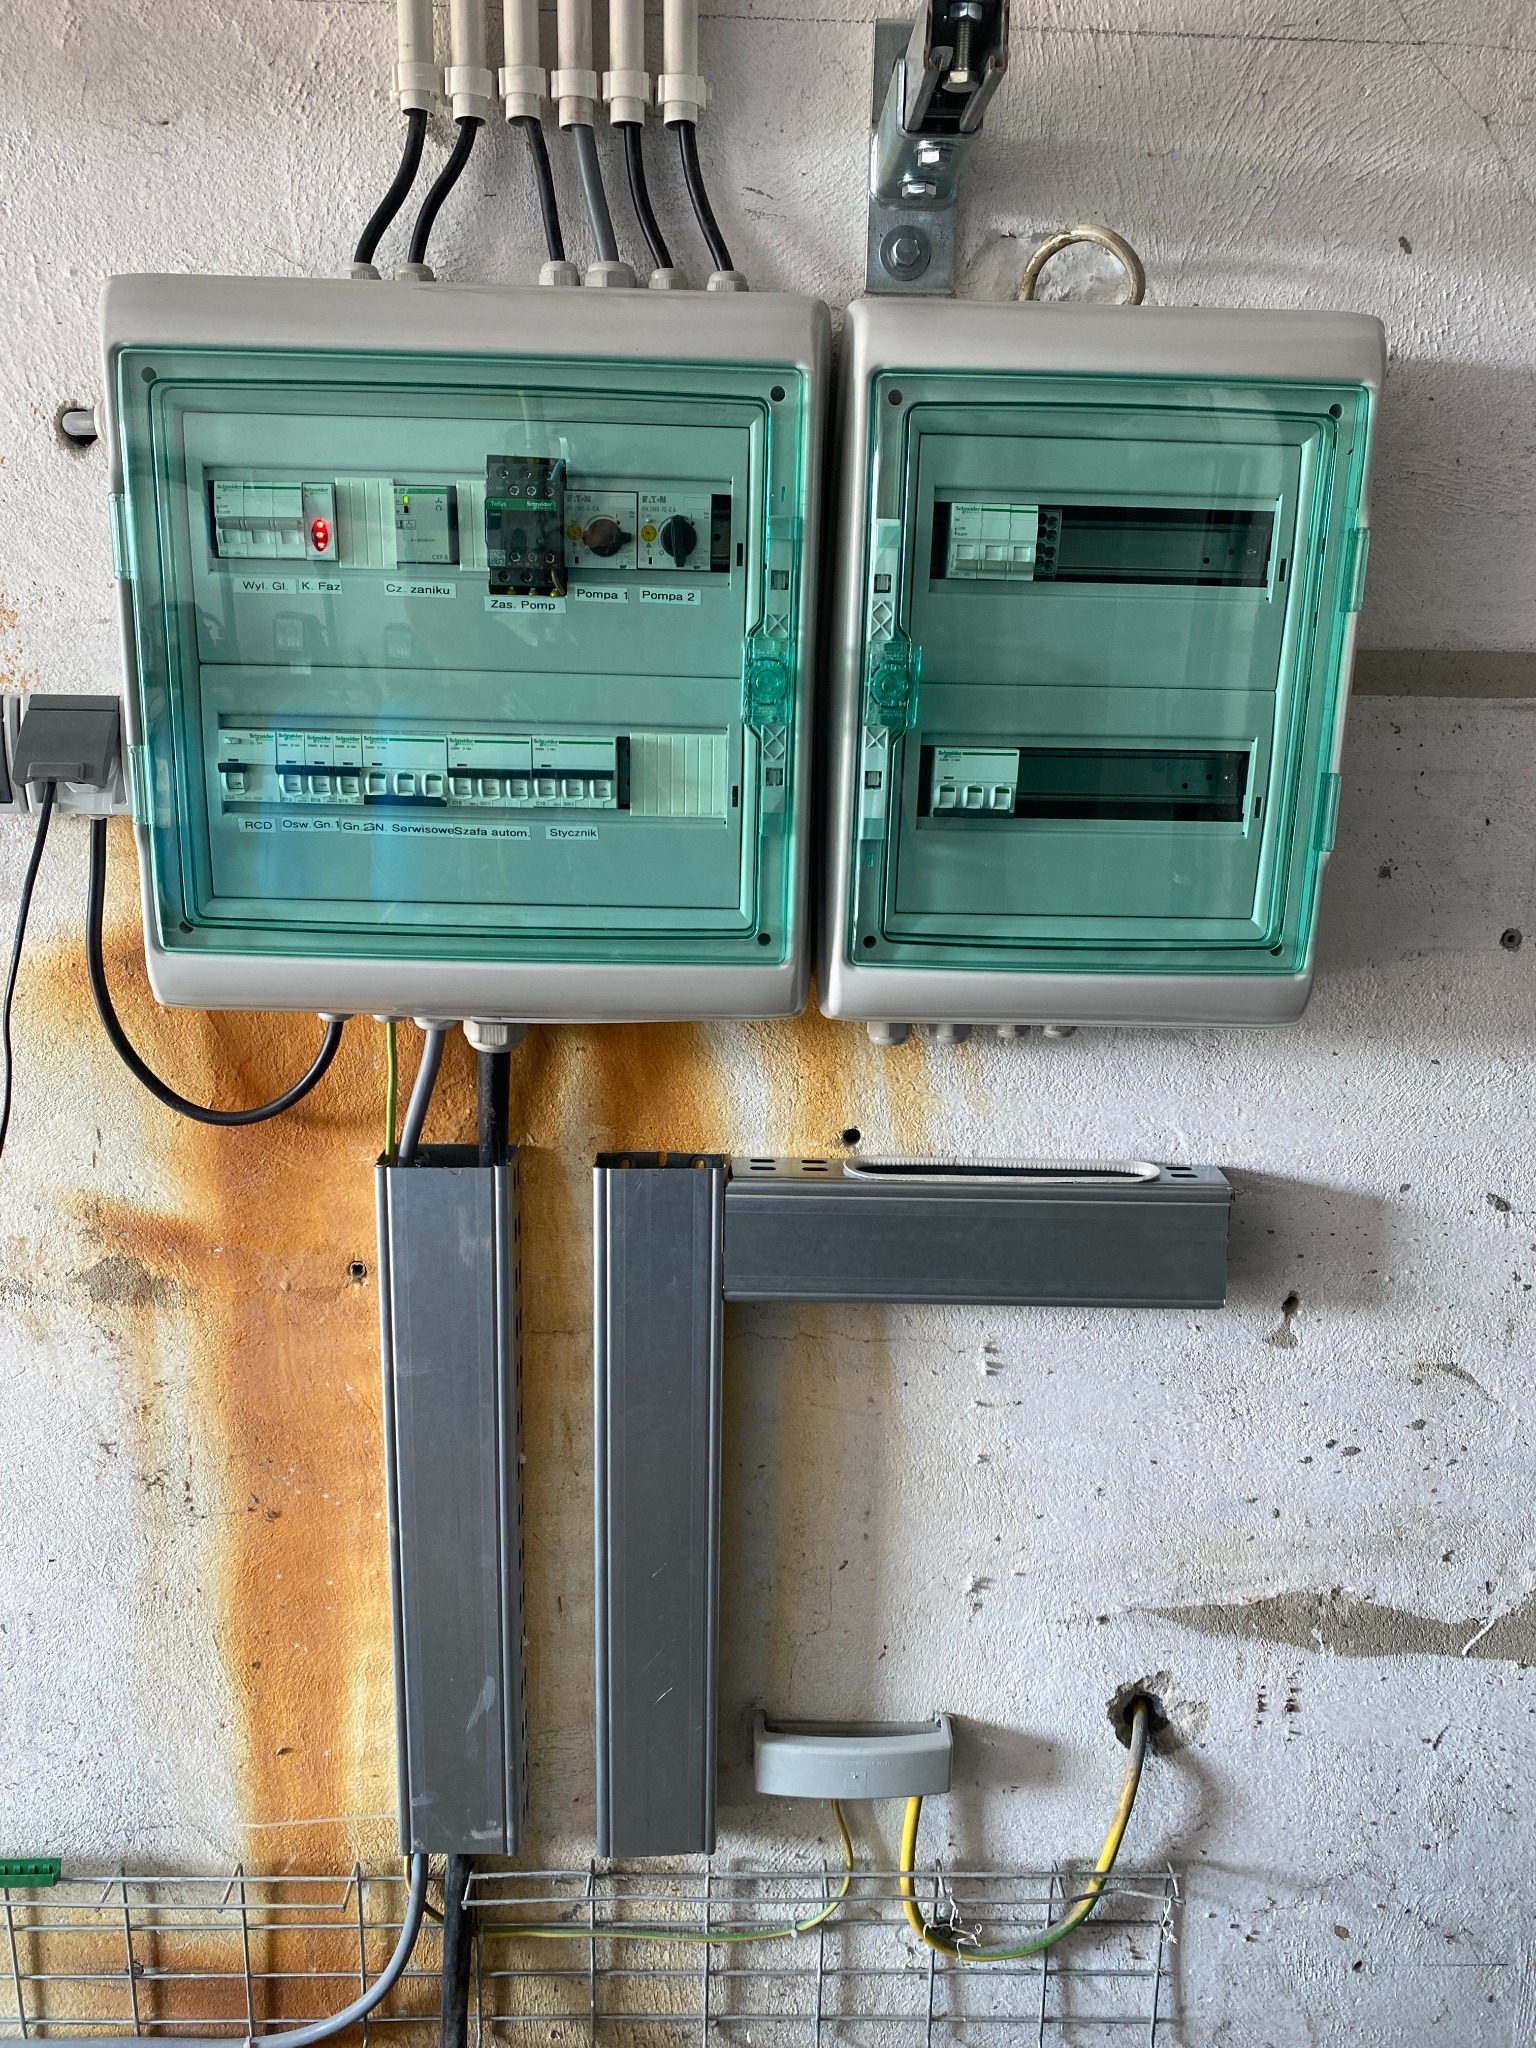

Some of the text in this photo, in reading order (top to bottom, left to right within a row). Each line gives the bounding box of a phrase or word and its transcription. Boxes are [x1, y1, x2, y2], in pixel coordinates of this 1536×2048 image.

[301, 582, 341, 591] K. Faz
[386, 584, 450, 594] Cz. zaniku
[577, 589, 628, 600] Pompa 1
[642, 591, 695, 601] Pompa 2
[491, 600, 556, 611] Zas. Pomp
[245, 821, 272, 829] RCD
[282, 820, 312, 829] Osw.
[313, 820, 339, 829] Gn.1
[392, 824, 454, 835] Serwisowe
[455, 827, 531, 837] Szafa autom.
[549, 828, 597, 838] Stycznik
